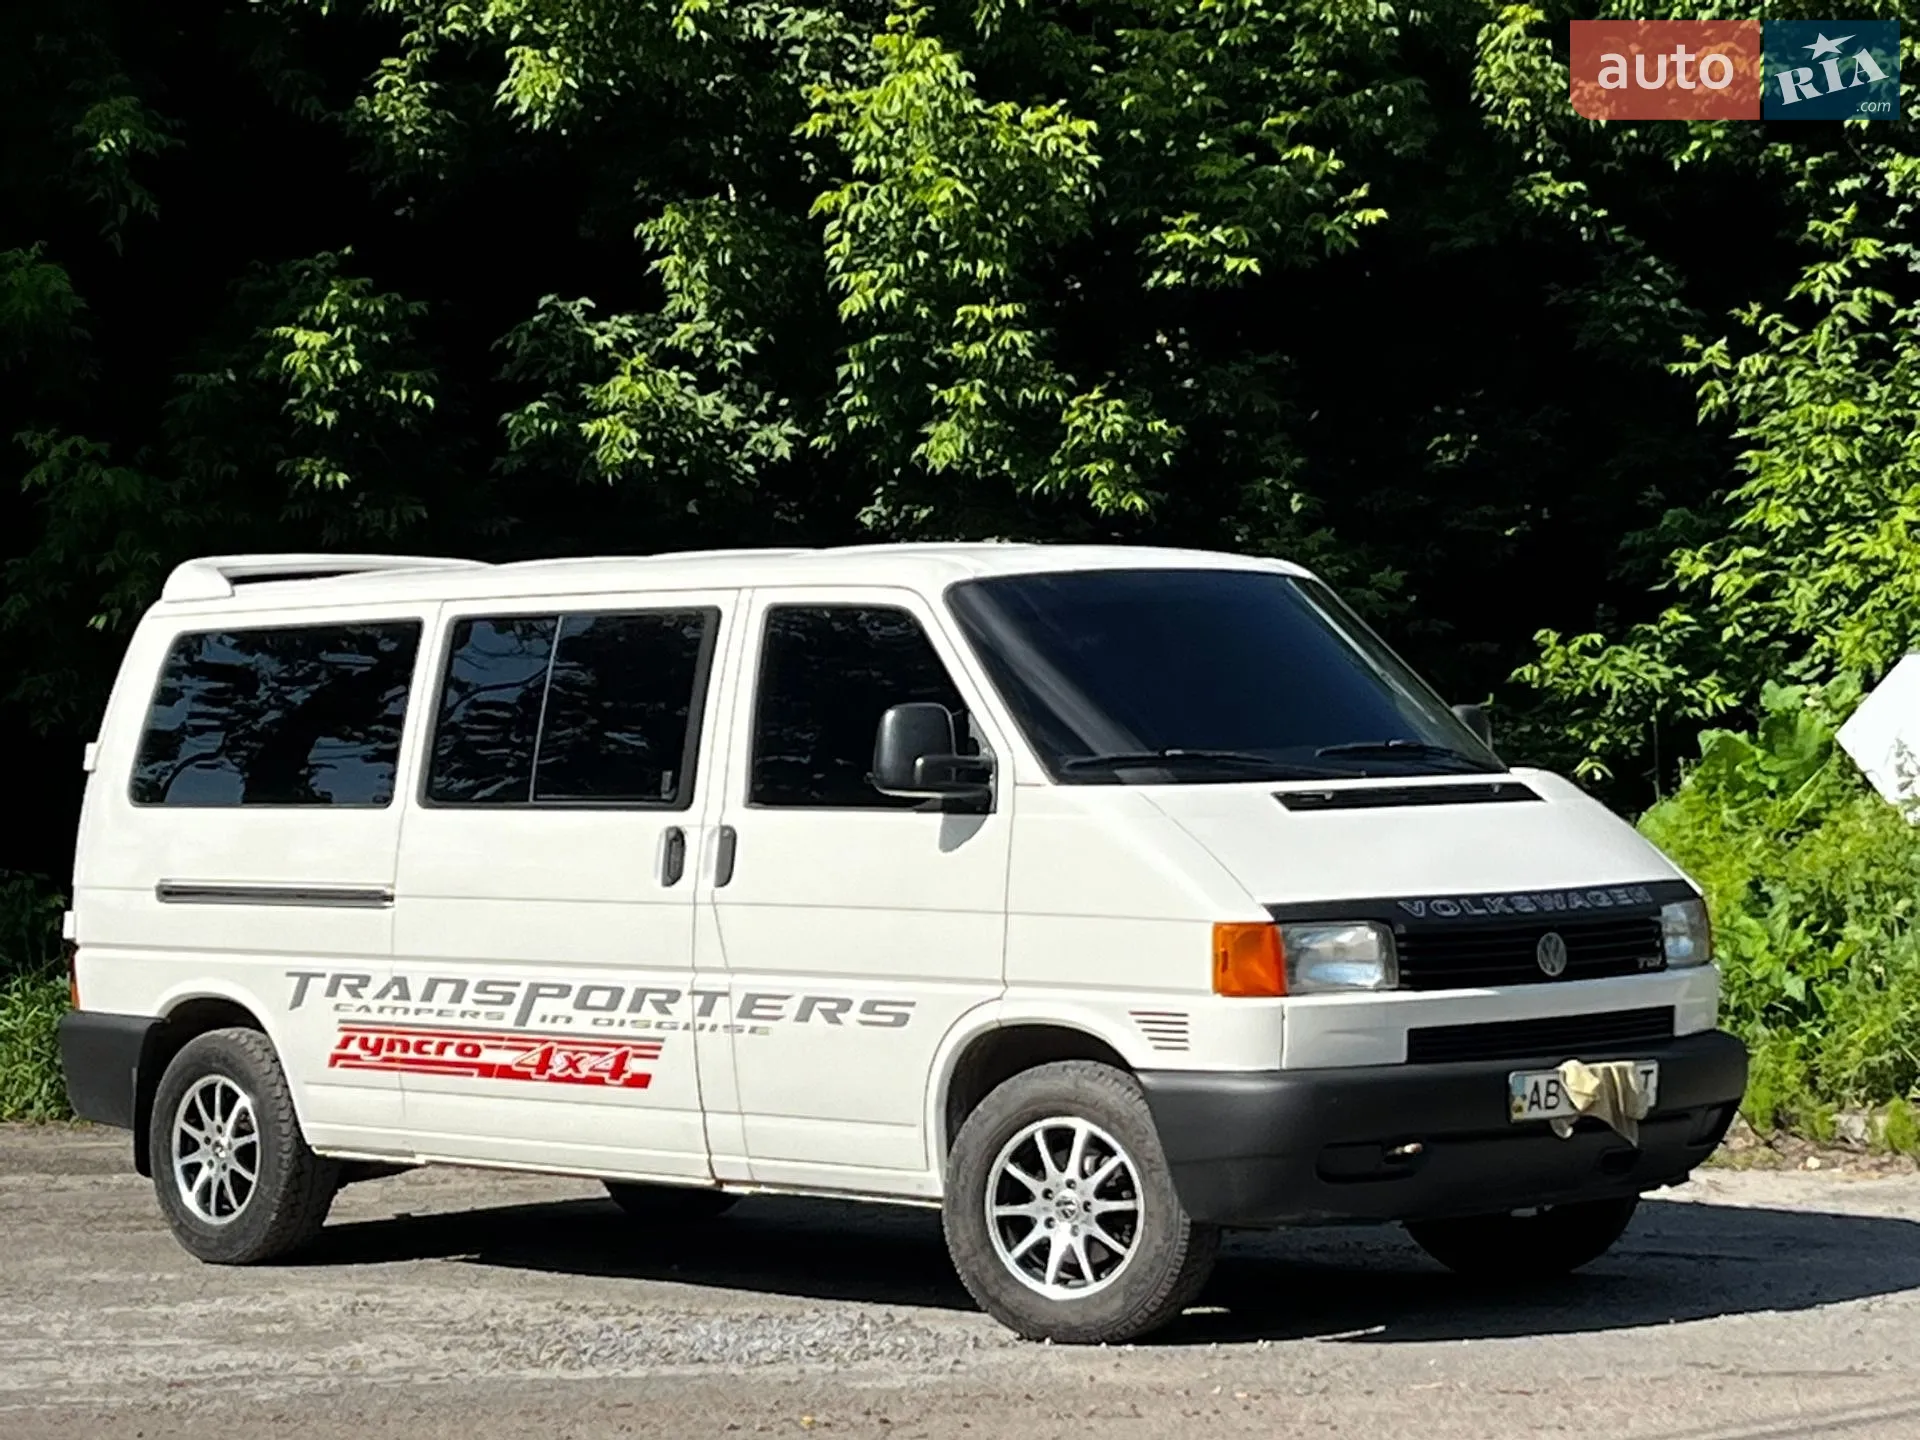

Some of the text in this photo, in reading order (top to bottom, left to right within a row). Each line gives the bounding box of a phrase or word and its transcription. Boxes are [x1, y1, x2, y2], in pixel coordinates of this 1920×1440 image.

[1397, 886, 1653, 918] VOLKSWAGEN
[286, 971, 916, 1028] TRANSPORTERS
[333, 1003, 504, 1022] CAMPERS
[591, 1017, 771, 1036] DISGUISE
[512, 1038, 634, 1084] 4x4
[1528, 1079, 1560, 1112] AB
